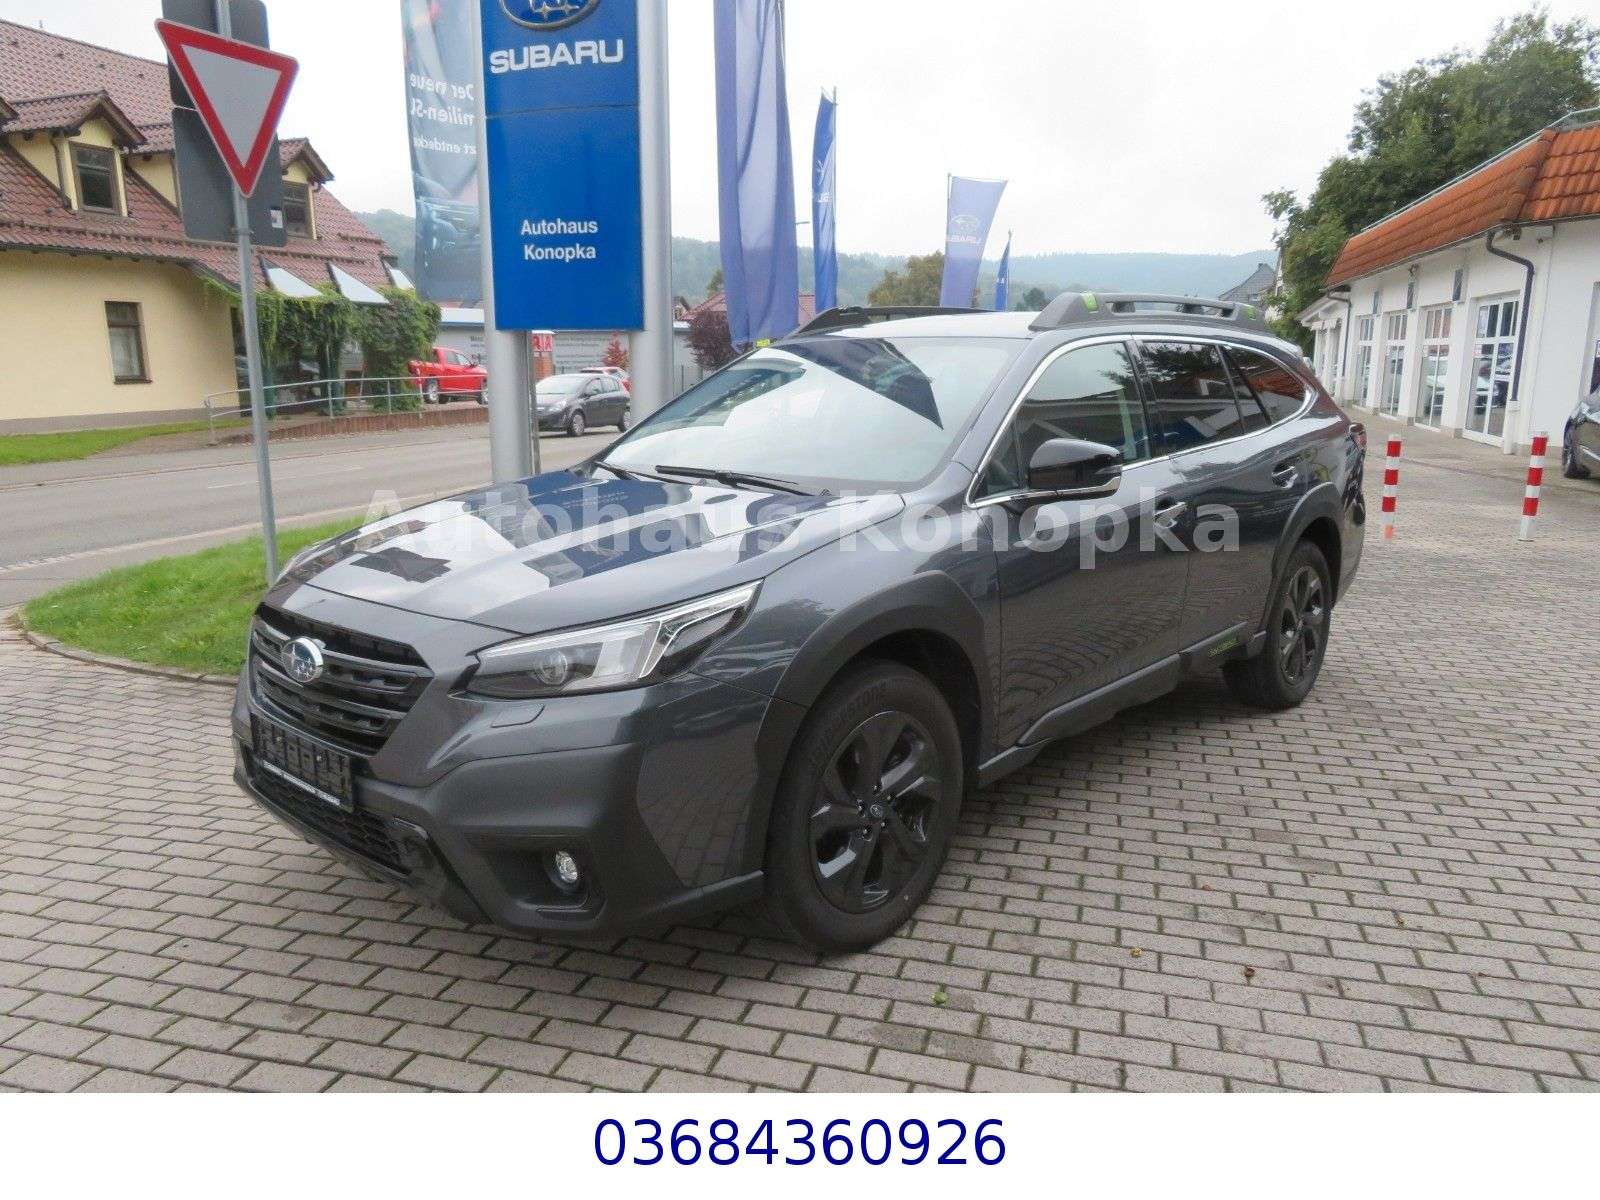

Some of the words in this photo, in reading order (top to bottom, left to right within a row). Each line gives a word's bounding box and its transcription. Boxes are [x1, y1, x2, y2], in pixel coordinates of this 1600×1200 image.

[489, 38, 625, 75] SUBARU
[520, 218, 599, 236] Autohaus
[523, 243, 597, 262] Konopka
